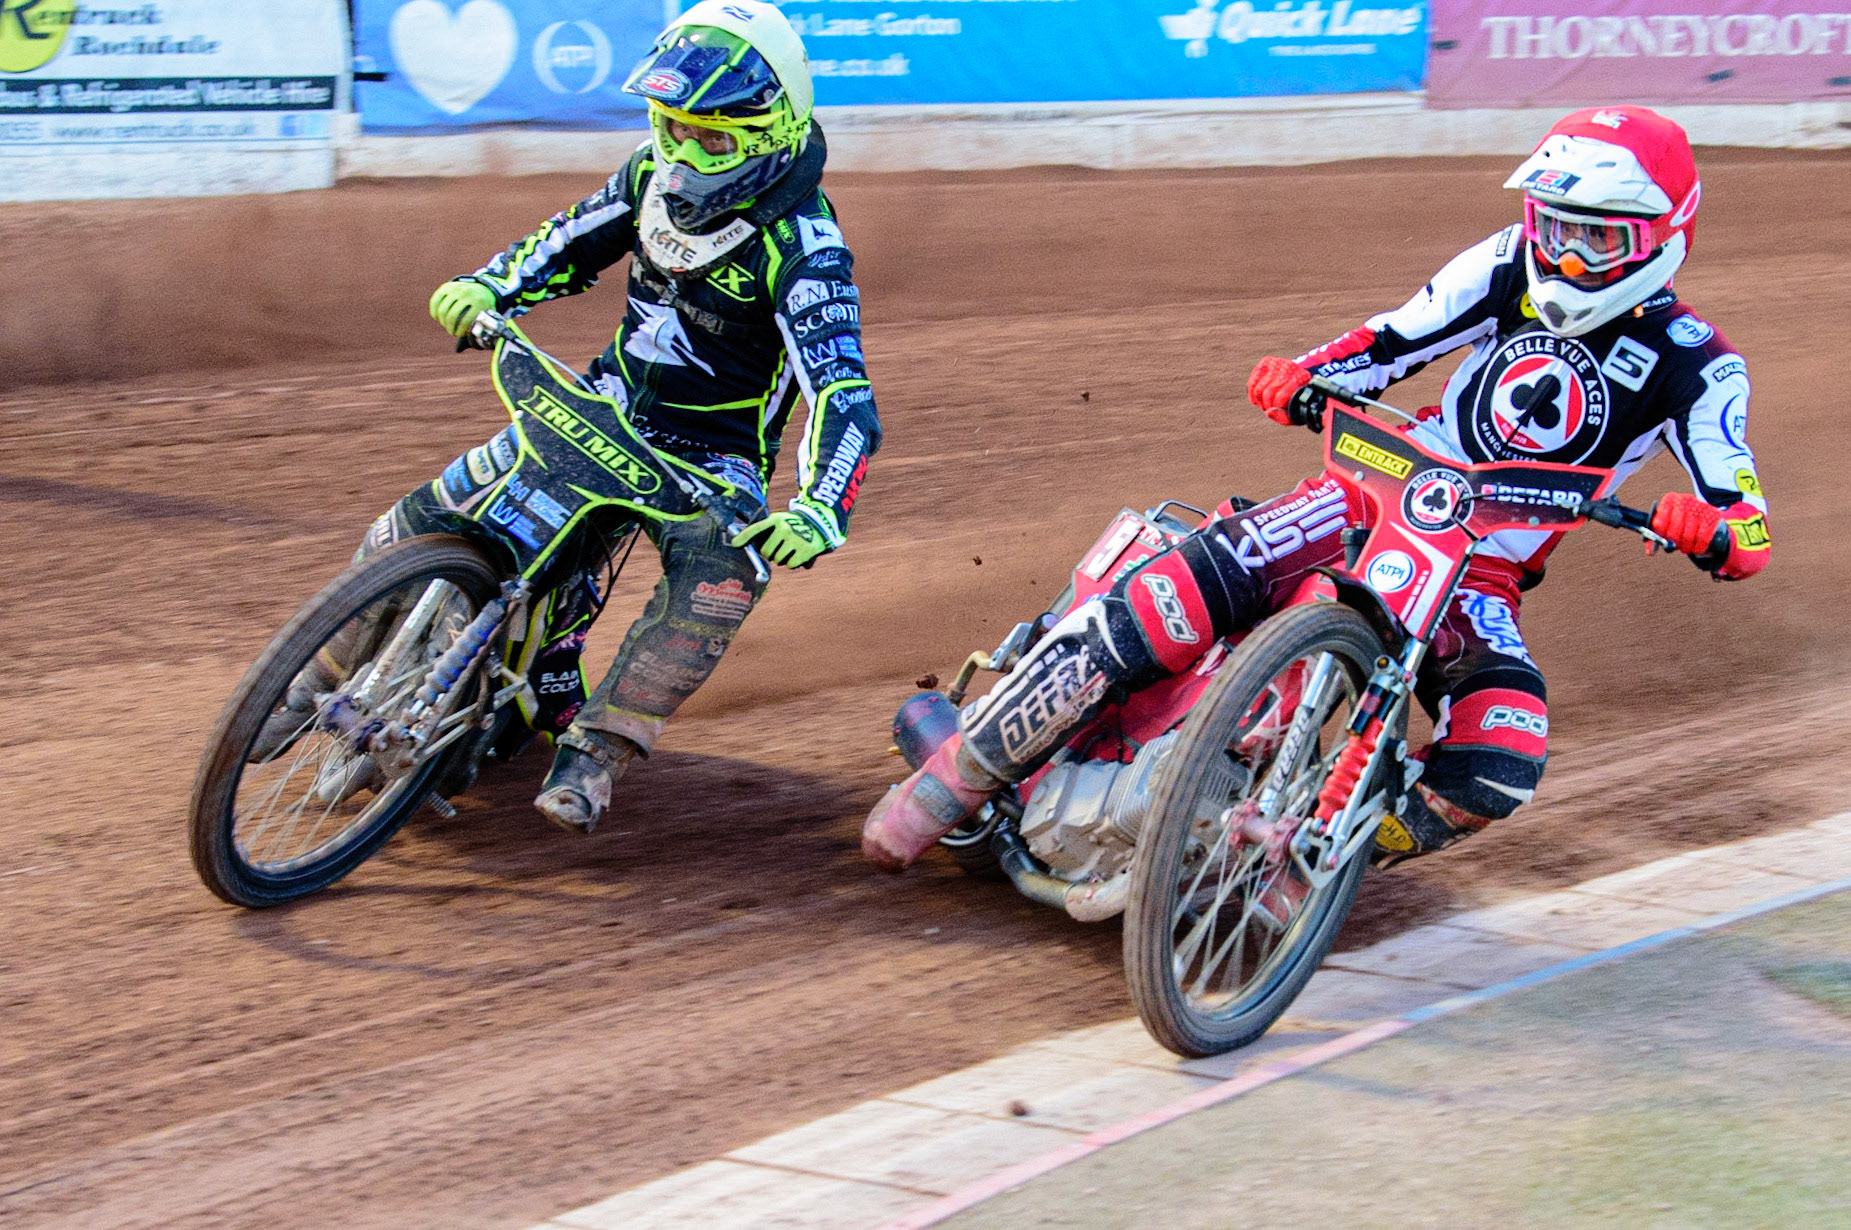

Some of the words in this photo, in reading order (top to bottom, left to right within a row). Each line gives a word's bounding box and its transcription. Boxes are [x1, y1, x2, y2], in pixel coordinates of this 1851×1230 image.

[1218, 0, 1329, 43] Quick
[1324, 0, 1423, 36] Lane
[1504, 339, 1555, 362] BELLE
[1560, 342, 1591, 373] VUE
[1585, 379, 1603, 426] ACES
[533, 396, 590, 440] TRU
[589, 438, 649, 486] MIX
[1358, 443, 1406, 474] ENTRACK
[811, 421, 866, 508] SPEEDWAY
[1253, 495, 1310, 526] SPEEDWAY
[1376, 563, 1405, 581] ATPI
